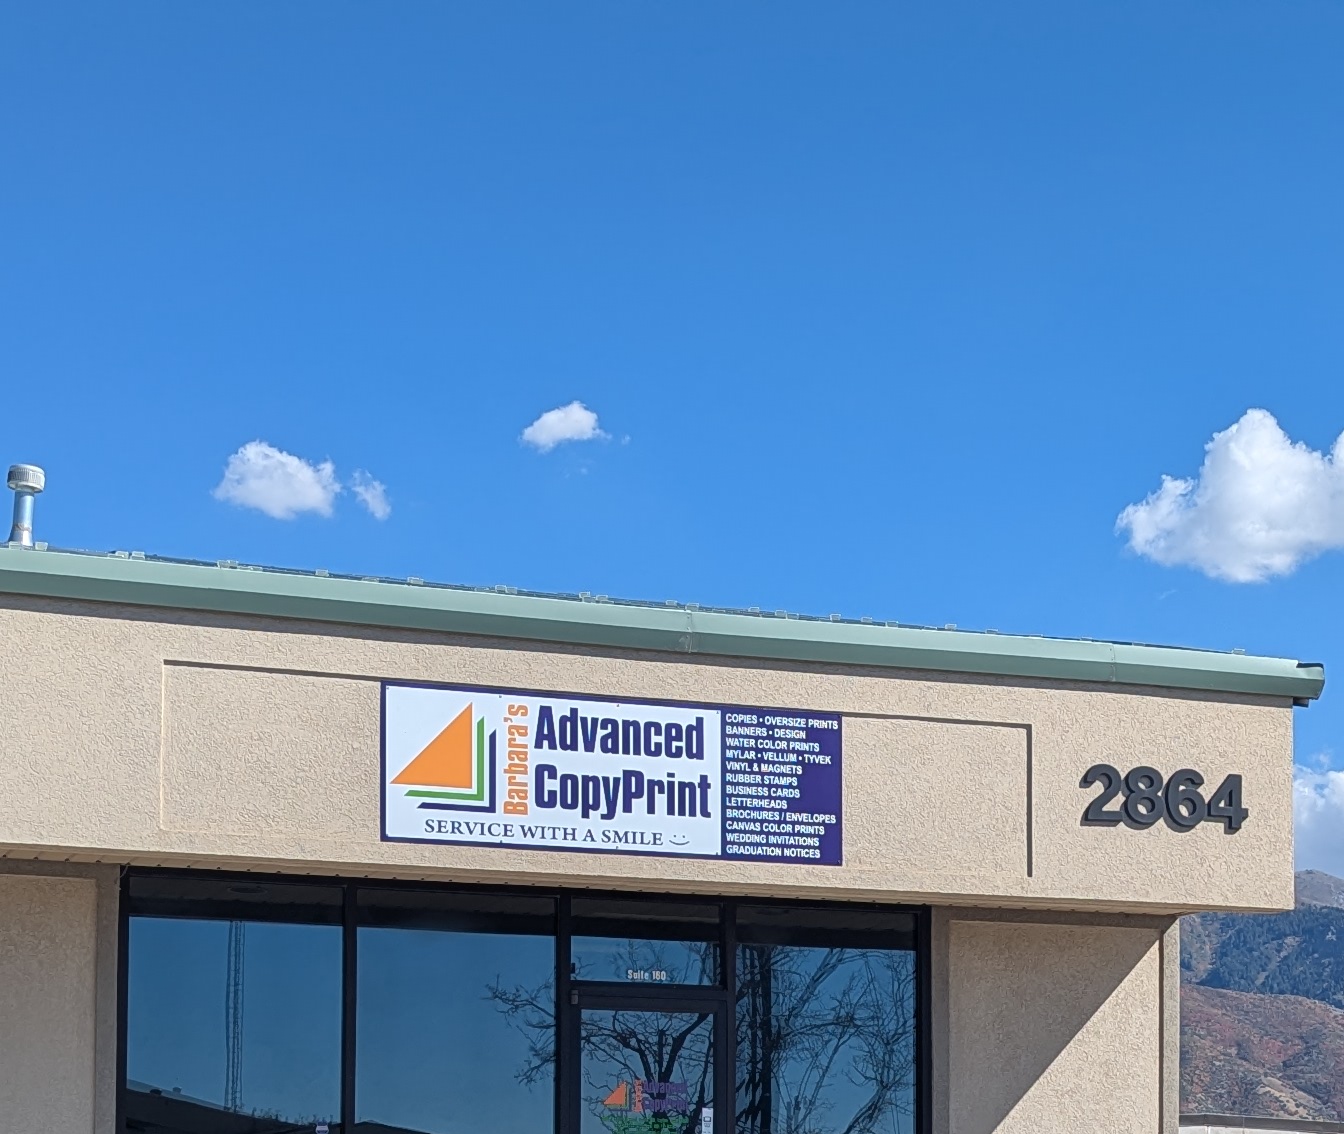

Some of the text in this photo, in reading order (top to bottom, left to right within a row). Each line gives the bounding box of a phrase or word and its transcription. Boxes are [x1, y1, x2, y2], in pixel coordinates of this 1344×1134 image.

[725, 713, 838, 729] COPIES OVERSIZE PRINTS
[534, 705, 705, 761] Advanced
[725, 725, 806, 739] BANNERS DESIGN
[725, 737, 820, 752] WATER COLOR PRINTS
[503, 704, 529, 816] Barbara's
[725, 749, 832, 764] MYLAR VELLUM TYVEK
[725, 761, 803, 775] VINYL & MAGNETS
[725, 773, 798, 786] RUBBER STAMPS
[534, 763, 712, 821] CopyPrint
[725, 785, 800, 798] BUSINESS CARDS
[1079, 763, 1247, 834] 2864
[725, 797, 787, 809] LETTERHEADS
[725, 809, 779, 820] BROCHURES
[786, 812, 836, 823] ENVELOPES
[424, 818, 664, 846] SERVICE WITH A SMILE
[725, 821, 825, 835] CANVAS COLOR PRINTS
[725, 832, 820, 846] WEDDING INVITATIONS
[725, 845, 821, 859] GRADUATION NOTICES
[627, 969, 666, 981] Suite 160
